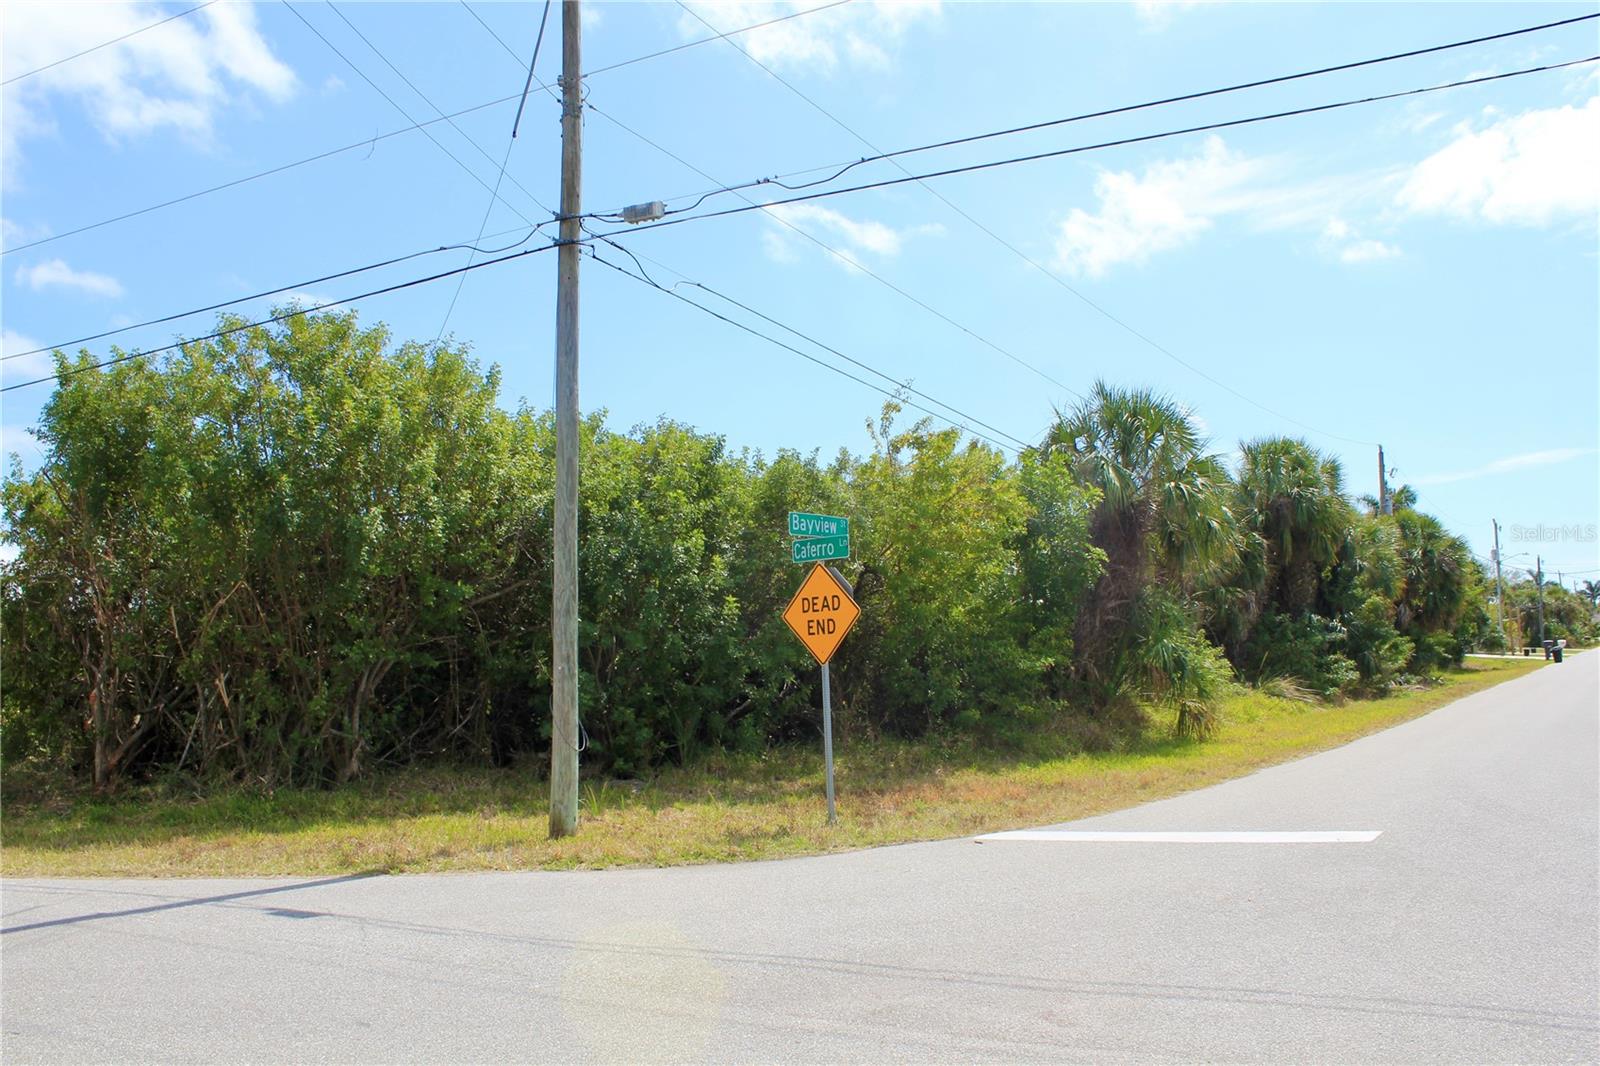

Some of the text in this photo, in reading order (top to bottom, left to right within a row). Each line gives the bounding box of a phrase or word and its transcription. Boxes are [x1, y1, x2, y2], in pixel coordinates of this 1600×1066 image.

[792, 514, 846, 534] Bayview St
[794, 543, 834, 559] Caferro
[802, 595, 841, 613] DEAD
[807, 618, 836, 636] END
